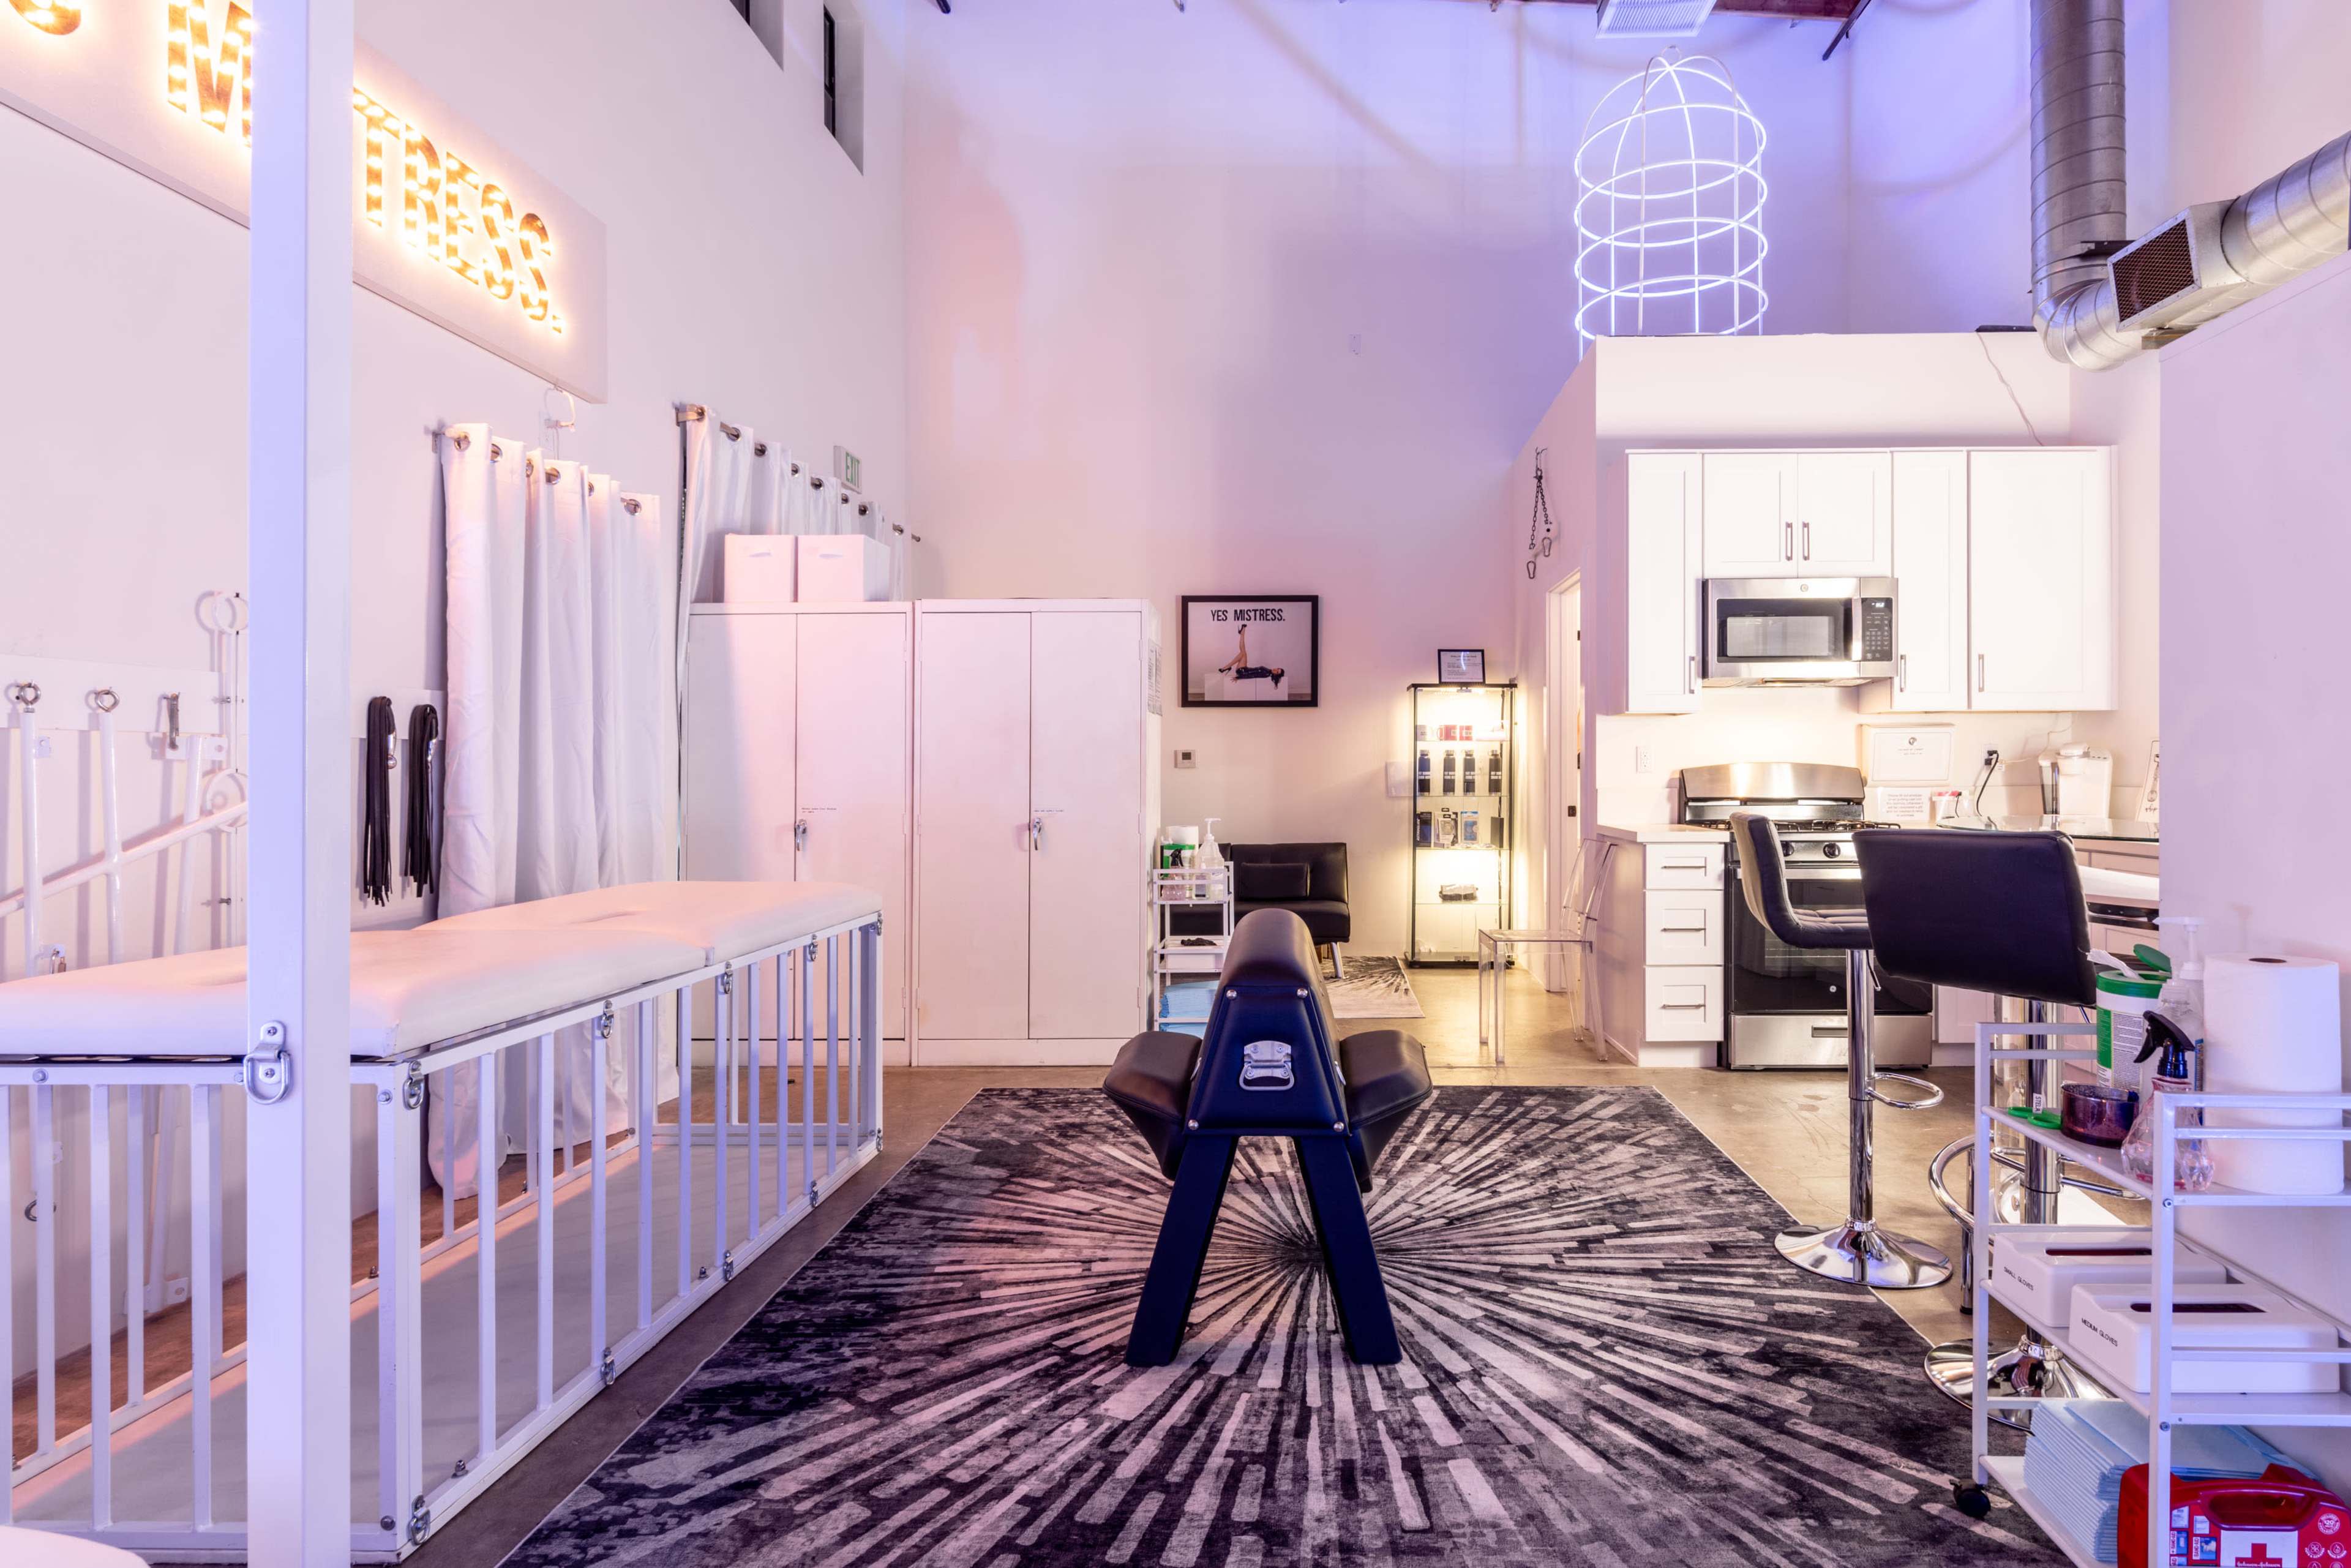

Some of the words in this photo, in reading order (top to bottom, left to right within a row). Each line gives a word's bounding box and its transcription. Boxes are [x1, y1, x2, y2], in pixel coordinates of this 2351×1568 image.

[167, 0, 563, 334] MTRESS.
[846, 451, 860, 489] EXIT
[1210, 610, 1228, 621] YES
[1234, 609, 1286, 621] MISTRESS.
[2004, 1266, 2016, 1279] SMALL
[2017, 1276, 2033, 1291] GLOVES
[2082, 1318, 2098, 1333] MEDIUM
[2099, 1330, 2118, 1347] GLOVES
